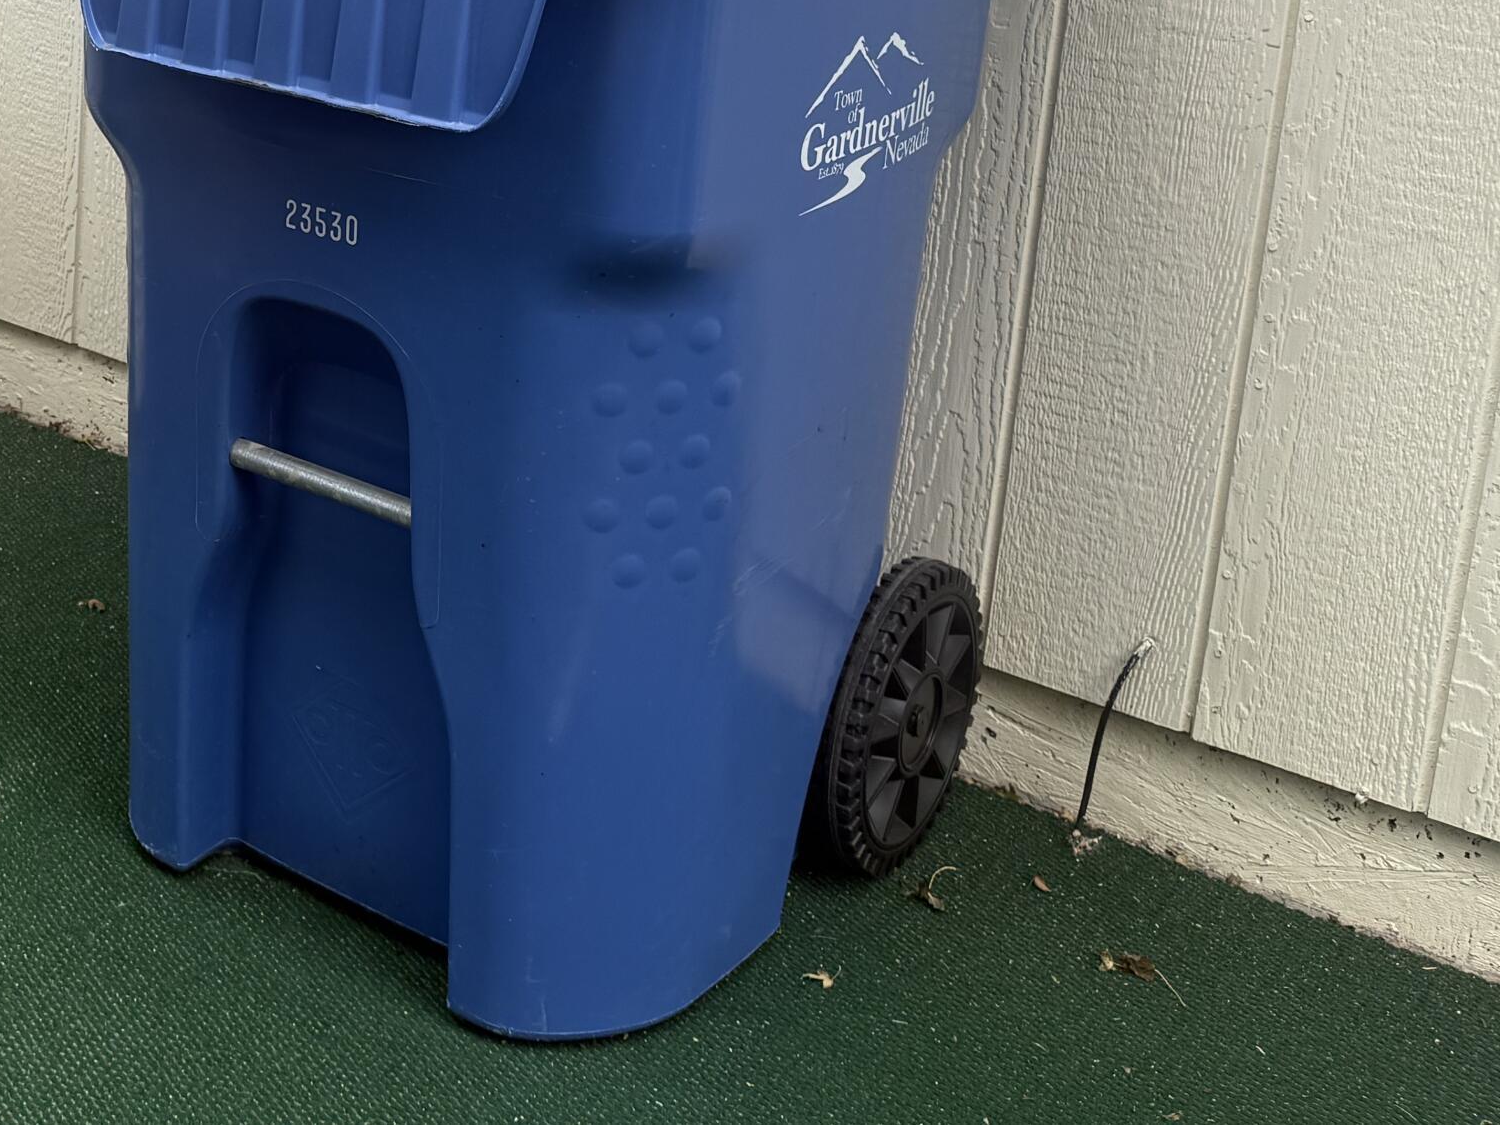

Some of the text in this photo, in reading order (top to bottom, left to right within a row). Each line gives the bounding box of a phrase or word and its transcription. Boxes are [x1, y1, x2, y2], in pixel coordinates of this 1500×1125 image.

[834, 88, 863, 111] Town
[847, 103, 861, 124] of
[800, 77, 935, 171] Gardnerville
[882, 121, 930, 170] Nevada
[285, 199, 358, 246] 23530
